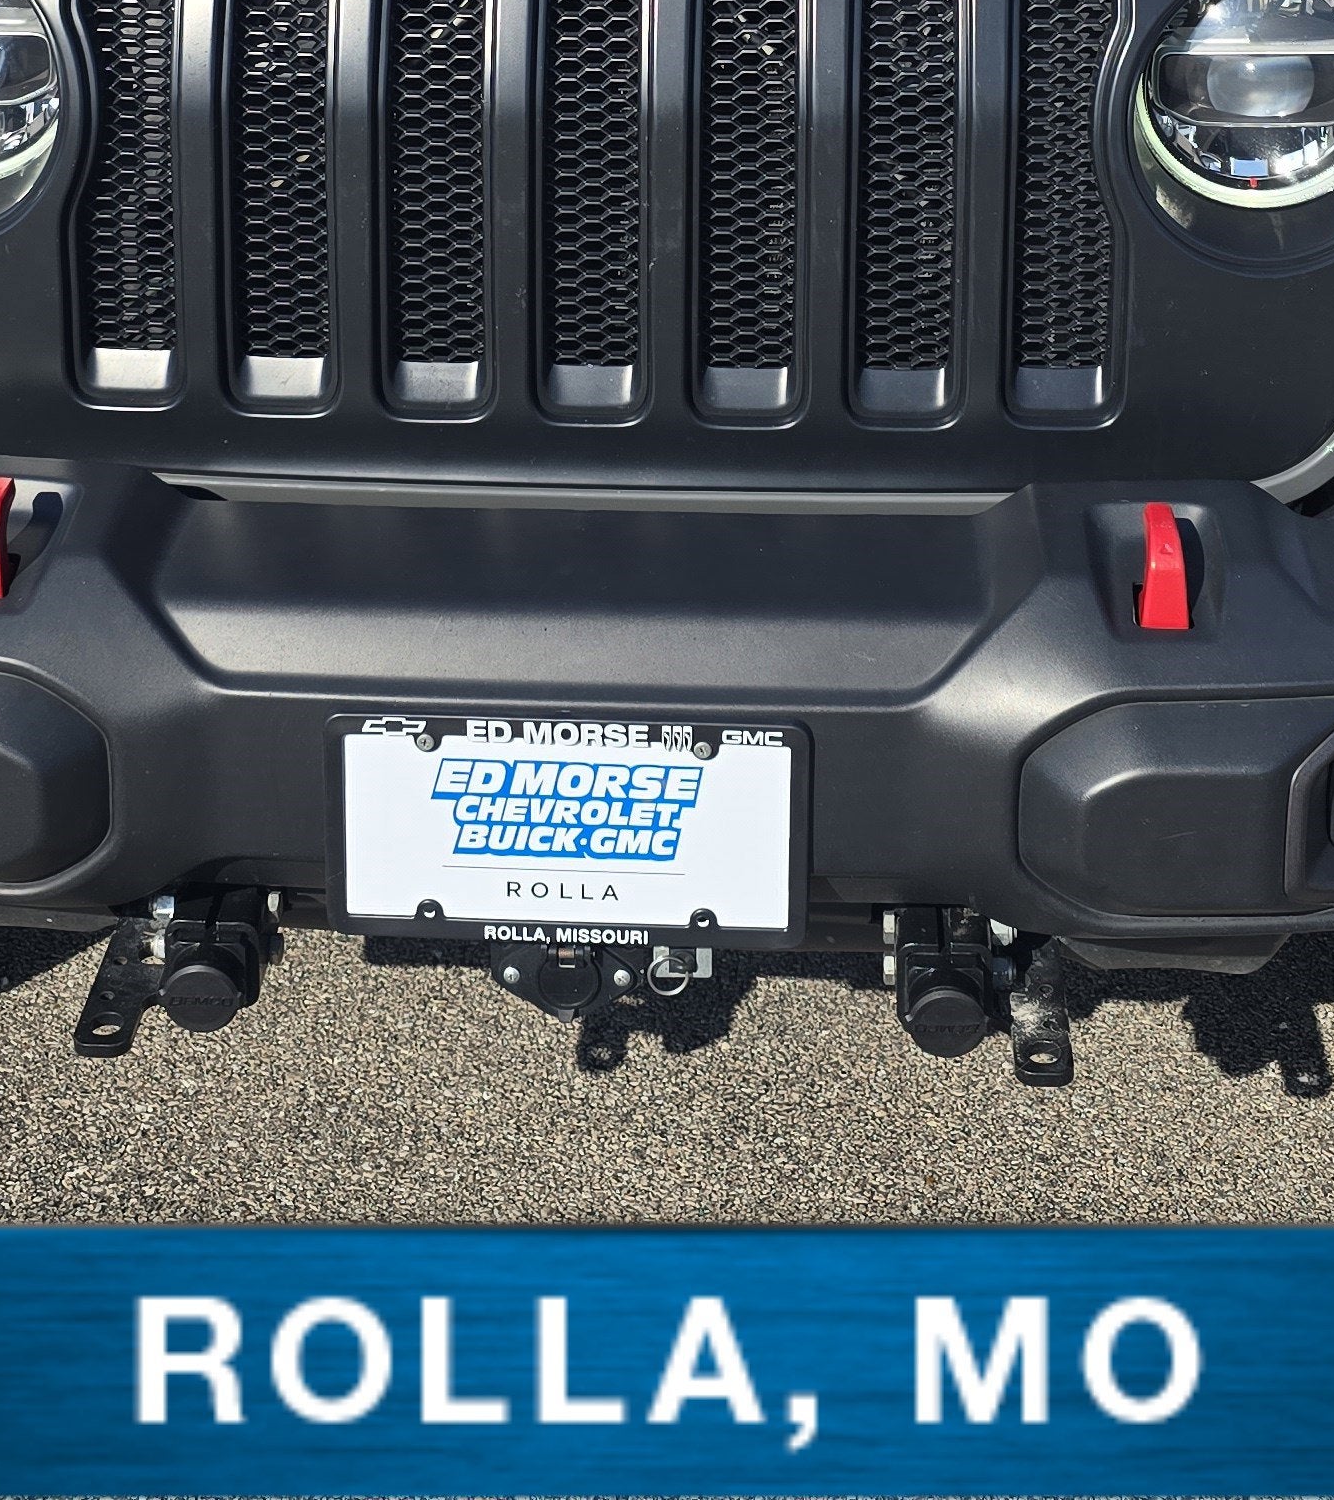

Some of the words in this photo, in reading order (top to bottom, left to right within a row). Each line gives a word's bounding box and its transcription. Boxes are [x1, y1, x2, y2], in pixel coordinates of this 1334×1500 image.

[466, 719, 514, 743] ED
[522, 721, 652, 748] MORSE
[721, 729, 784, 747] GMC
[434, 758, 508, 795] ED
[509, 761, 701, 801] MORSE
[455, 795, 680, 828] CHEVROLET
[506, 881, 619, 901] ROLLA
[483, 925, 551, 945] ROLLA,
[555, 927, 649, 945] MISSOURI
